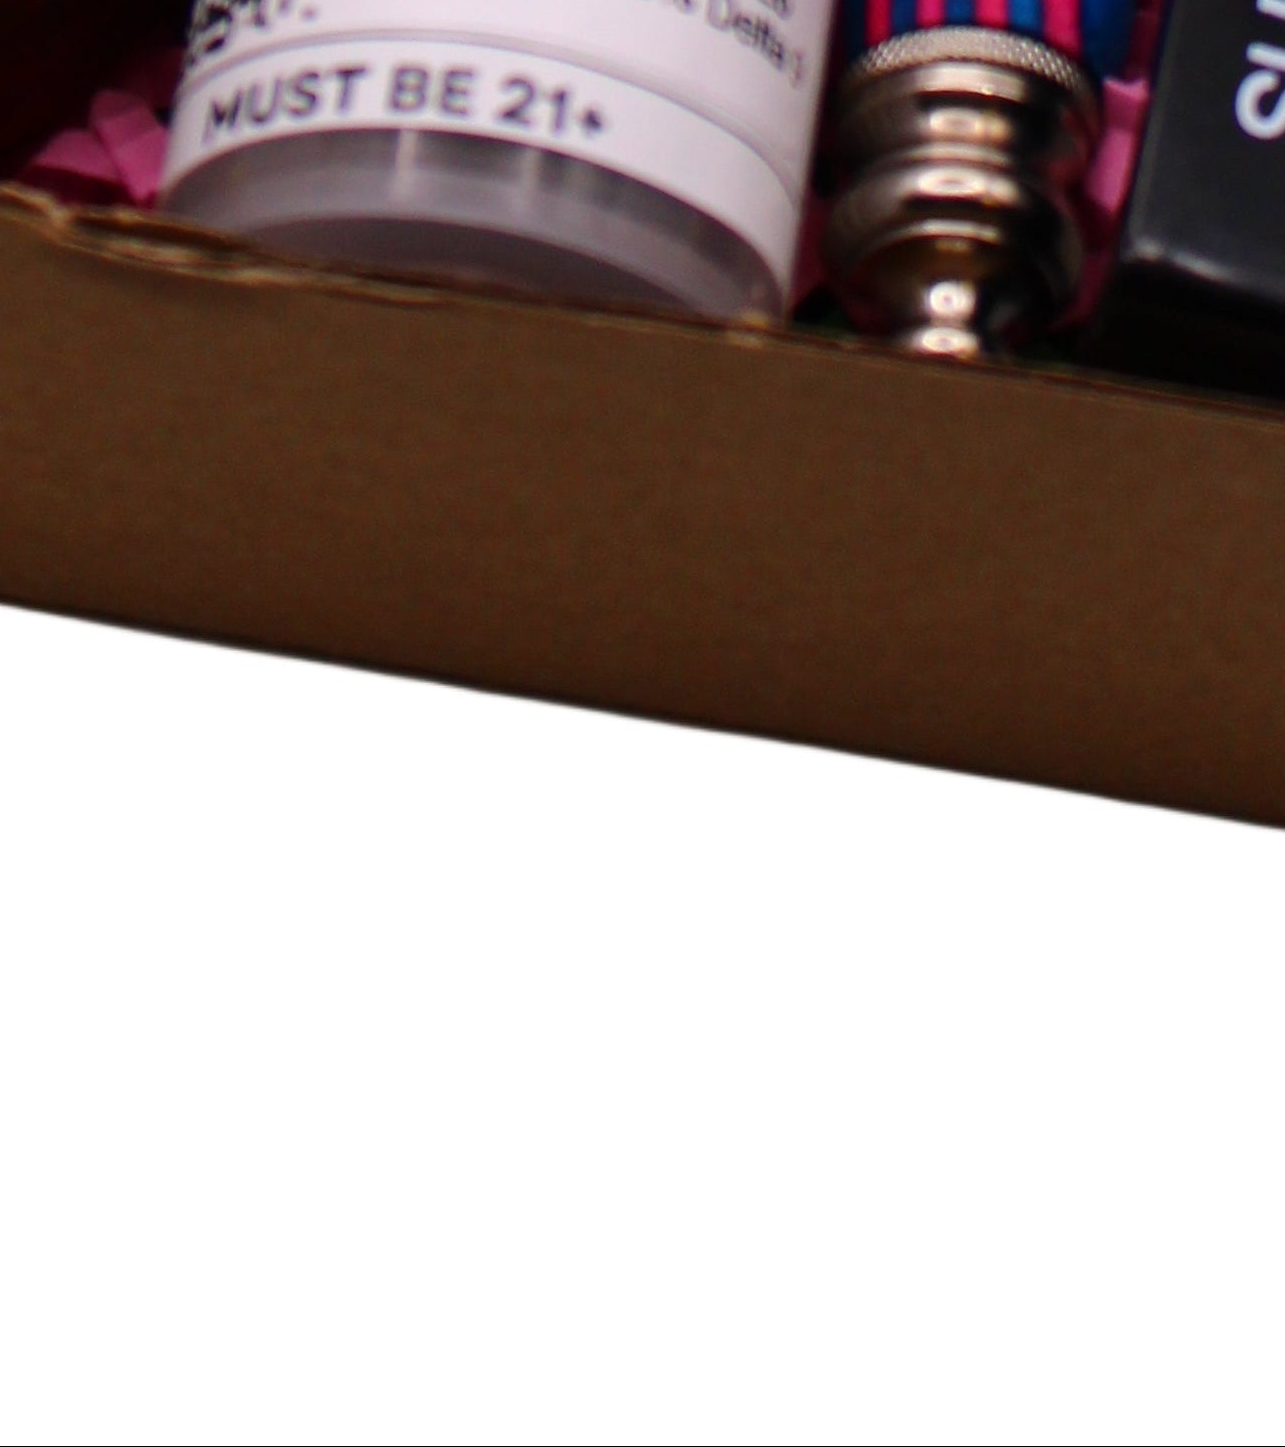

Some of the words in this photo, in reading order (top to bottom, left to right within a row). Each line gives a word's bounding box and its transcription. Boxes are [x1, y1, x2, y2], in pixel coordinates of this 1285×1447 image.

[201, 65, 367, 143] MUST
[390, 65, 477, 116] BE
[498, 75, 604, 133] 21+
